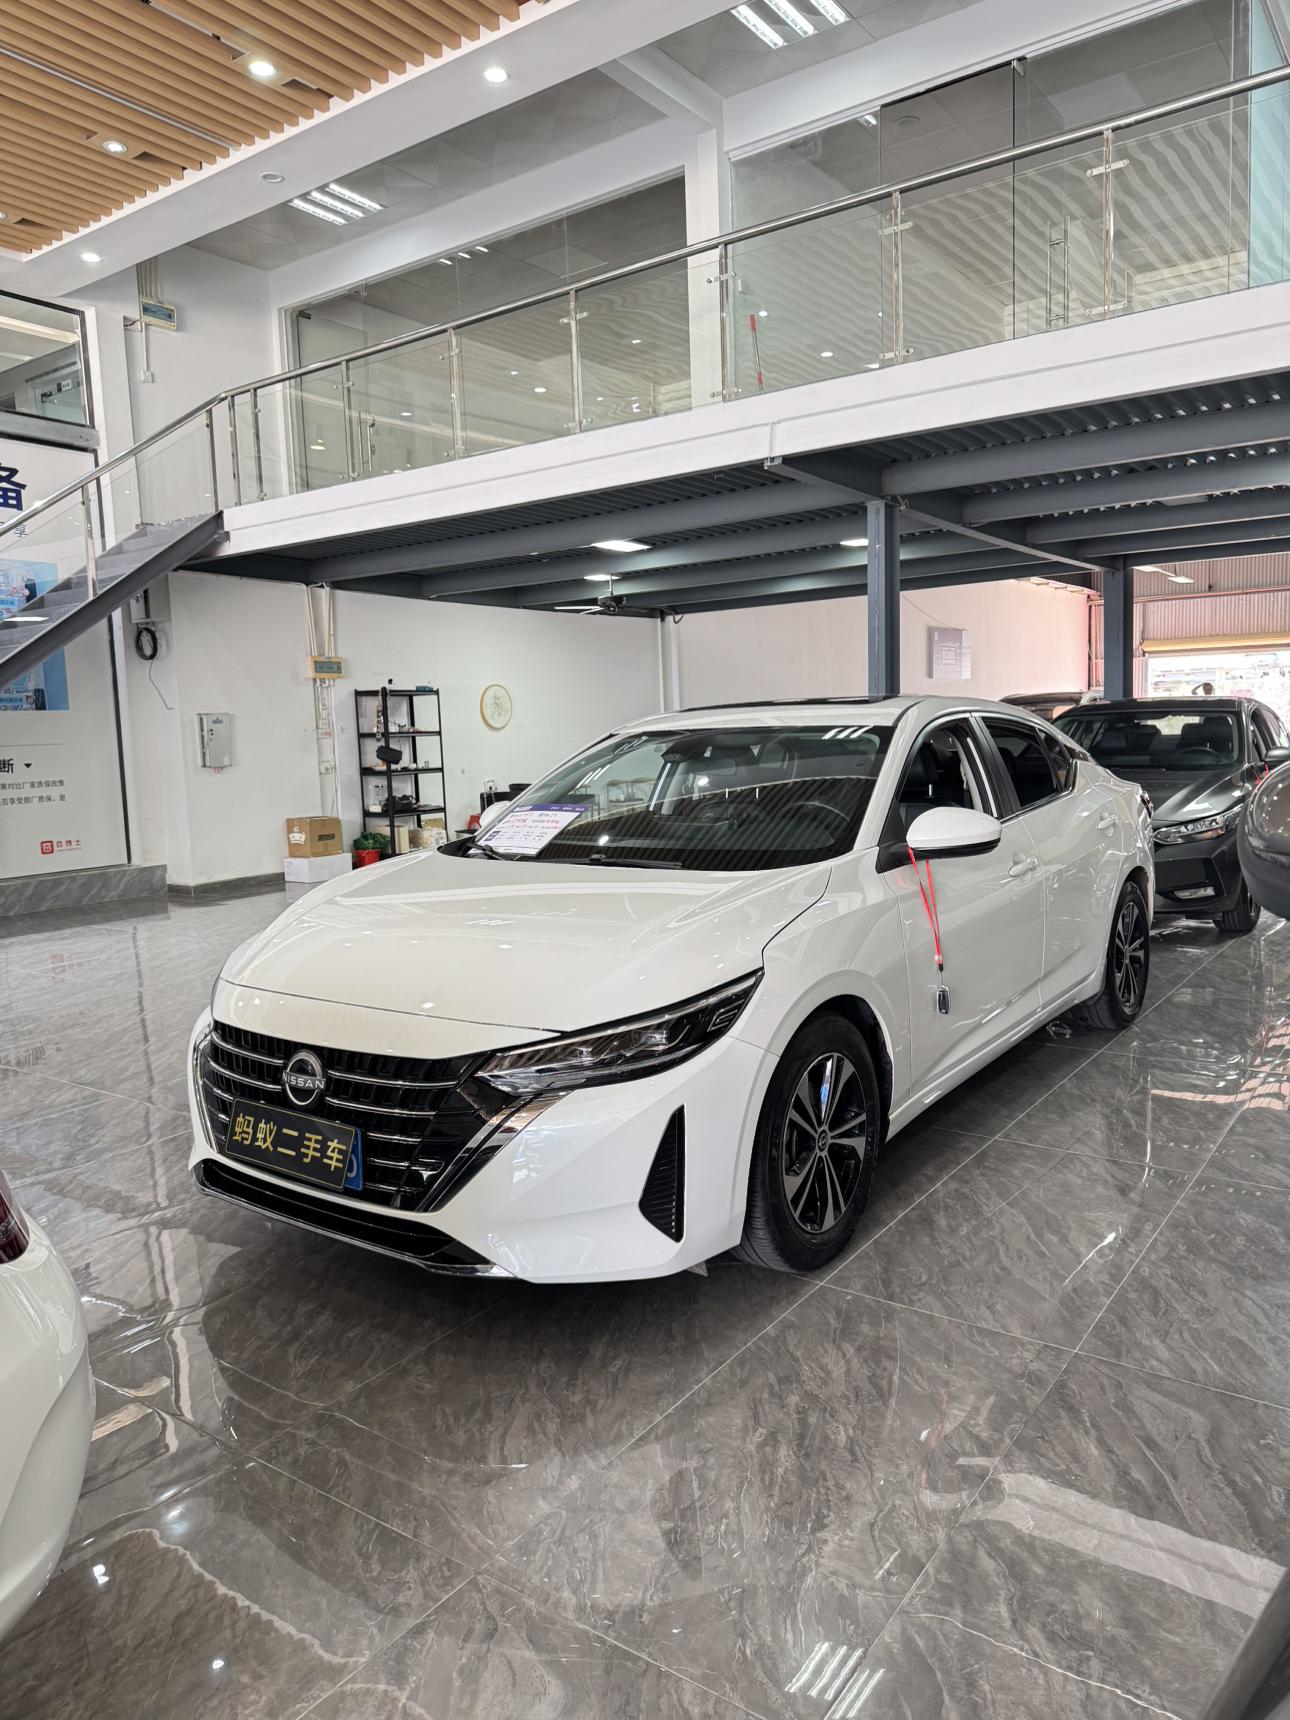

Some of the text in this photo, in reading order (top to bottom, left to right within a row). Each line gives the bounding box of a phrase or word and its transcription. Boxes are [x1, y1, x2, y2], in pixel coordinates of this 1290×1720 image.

[282, 1070, 326, 1090] NISSAN
[232, 1113, 347, 1172] 蚂蚁二手车
